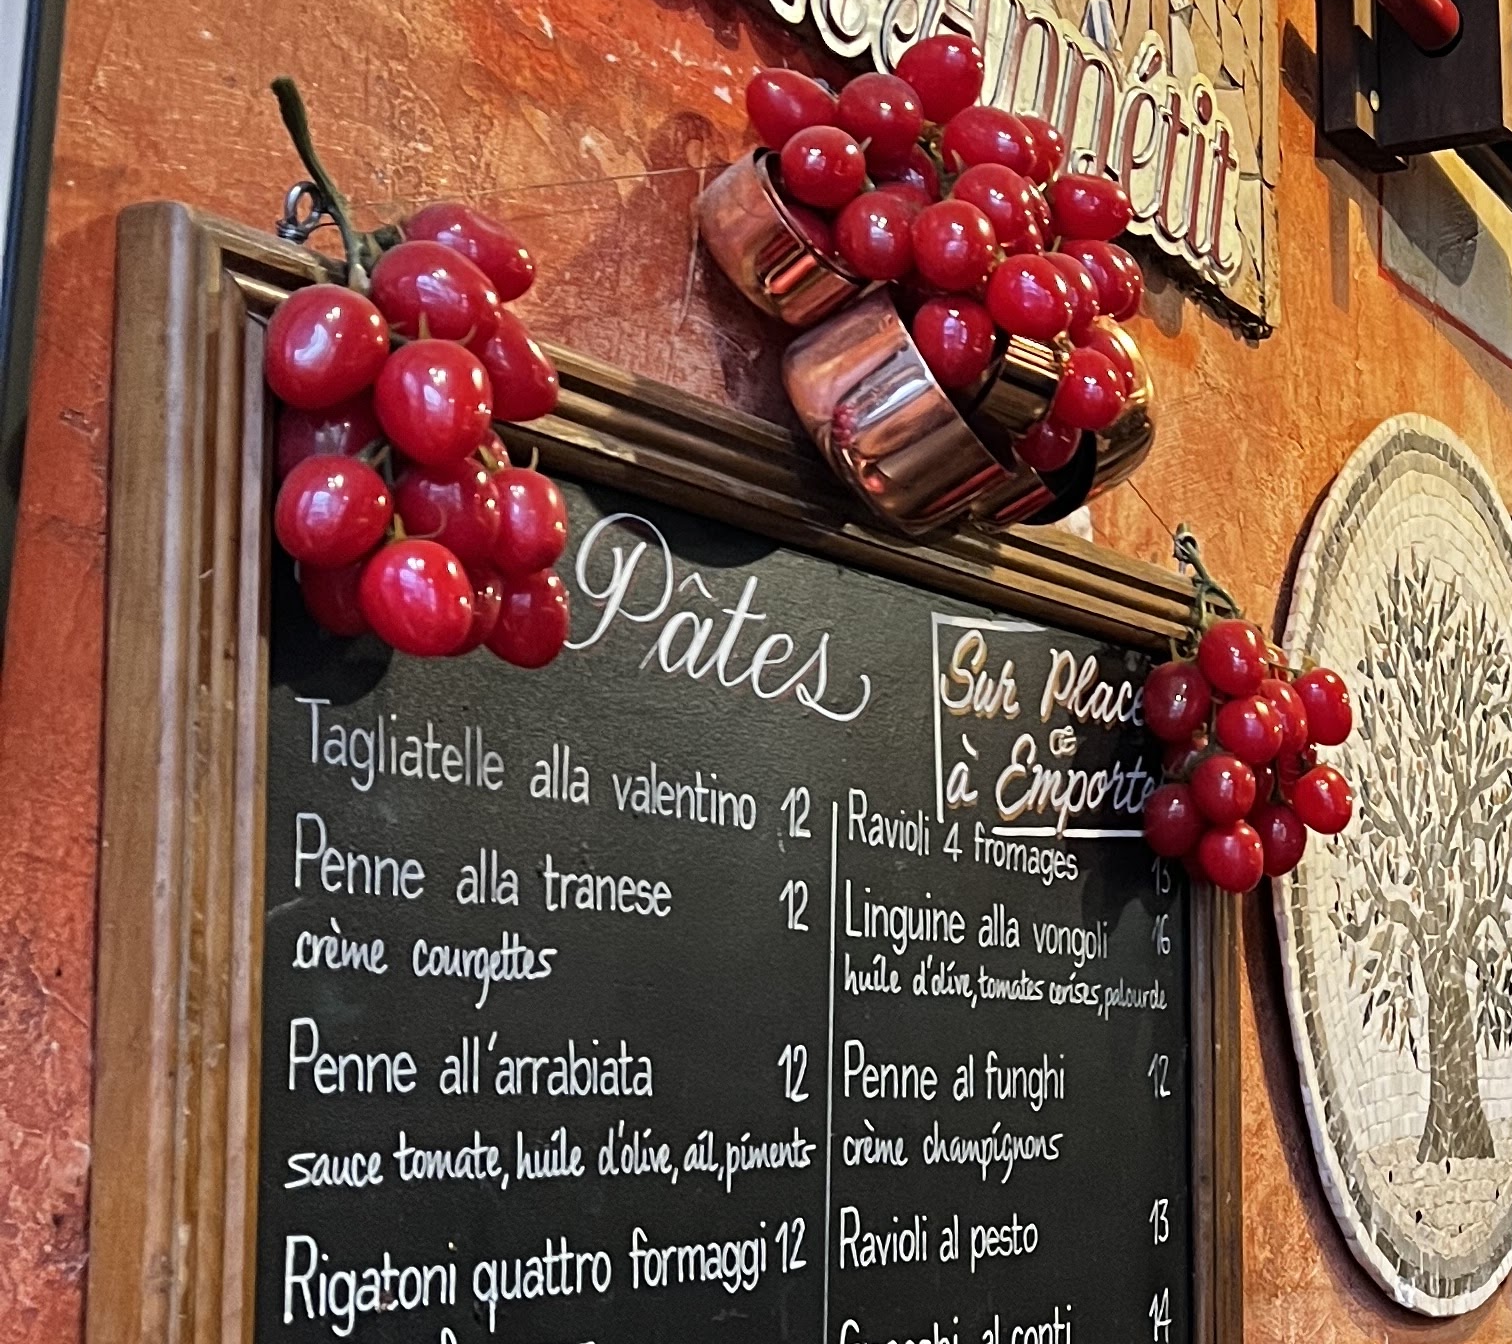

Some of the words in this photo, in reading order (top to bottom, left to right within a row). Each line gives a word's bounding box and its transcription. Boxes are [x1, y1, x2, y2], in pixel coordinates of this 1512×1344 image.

[563, 511, 871, 722] Pâtes
[941, 629, 1020, 720] Sur
[295, 697, 504, 792] Tagliatelle
[529, 743, 591, 805] alla
[612, 762, 758, 831] valentino
[780, 787, 812, 839] 12
[947, 733, 979, 808] à
[995, 733, 1156, 838] Emporte
[293, 811, 426, 900] Penne
[456, 847, 519, 906] alla
[543, 853, 673, 918] tranese
[779, 879, 810, 932] 12
[847, 788, 931, 857] Ravioli
[943, 822, 963, 863] 4
[974, 823, 1080, 886] fromages
[292, 917, 389, 975] crème
[411, 931, 558, 1010] courgettes
[843, 879, 966, 955] Linguine
[978, 903, 1021, 950] alla
[1032, 920, 1108, 969] vongoli
[1151, 913, 1172, 956] 16
[843, 953, 902, 996] huile
[977, 972, 1045, 1005] tomates
[288, 1017, 417, 1094] Penne
[438, 1030, 654, 1097] all'arrabiata
[777, 1043, 808, 1103] 12
[843, 1038, 938, 1101] Penne
[952, 1054, 974, 1099] al
[985, 1050, 1066, 1112] funghi
[1147, 1053, 1172, 1098] 12
[284, 1149, 385, 1189] sauce
[393, 1130, 510, 1190] tomate,
[515, 1126, 586, 1178] huile
[725, 1127, 817, 1194] piments
[842, 1118, 909, 1167] crème
[922, 1119, 1064, 1184] champignons
[283, 1233, 457, 1338] Rigatoni
[471, 1237, 612, 1333] quattro
[628, 1220, 767, 1294] formaggi
[775, 1216, 807, 1275] 12
[839, 1205, 928, 1271] Ravioli
[939, 1215, 960, 1263] al
[970, 1213, 1039, 1274] pesto
[1148, 1197, 1170, 1246] 13
[1148, 1286, 1172, 1344] 14
